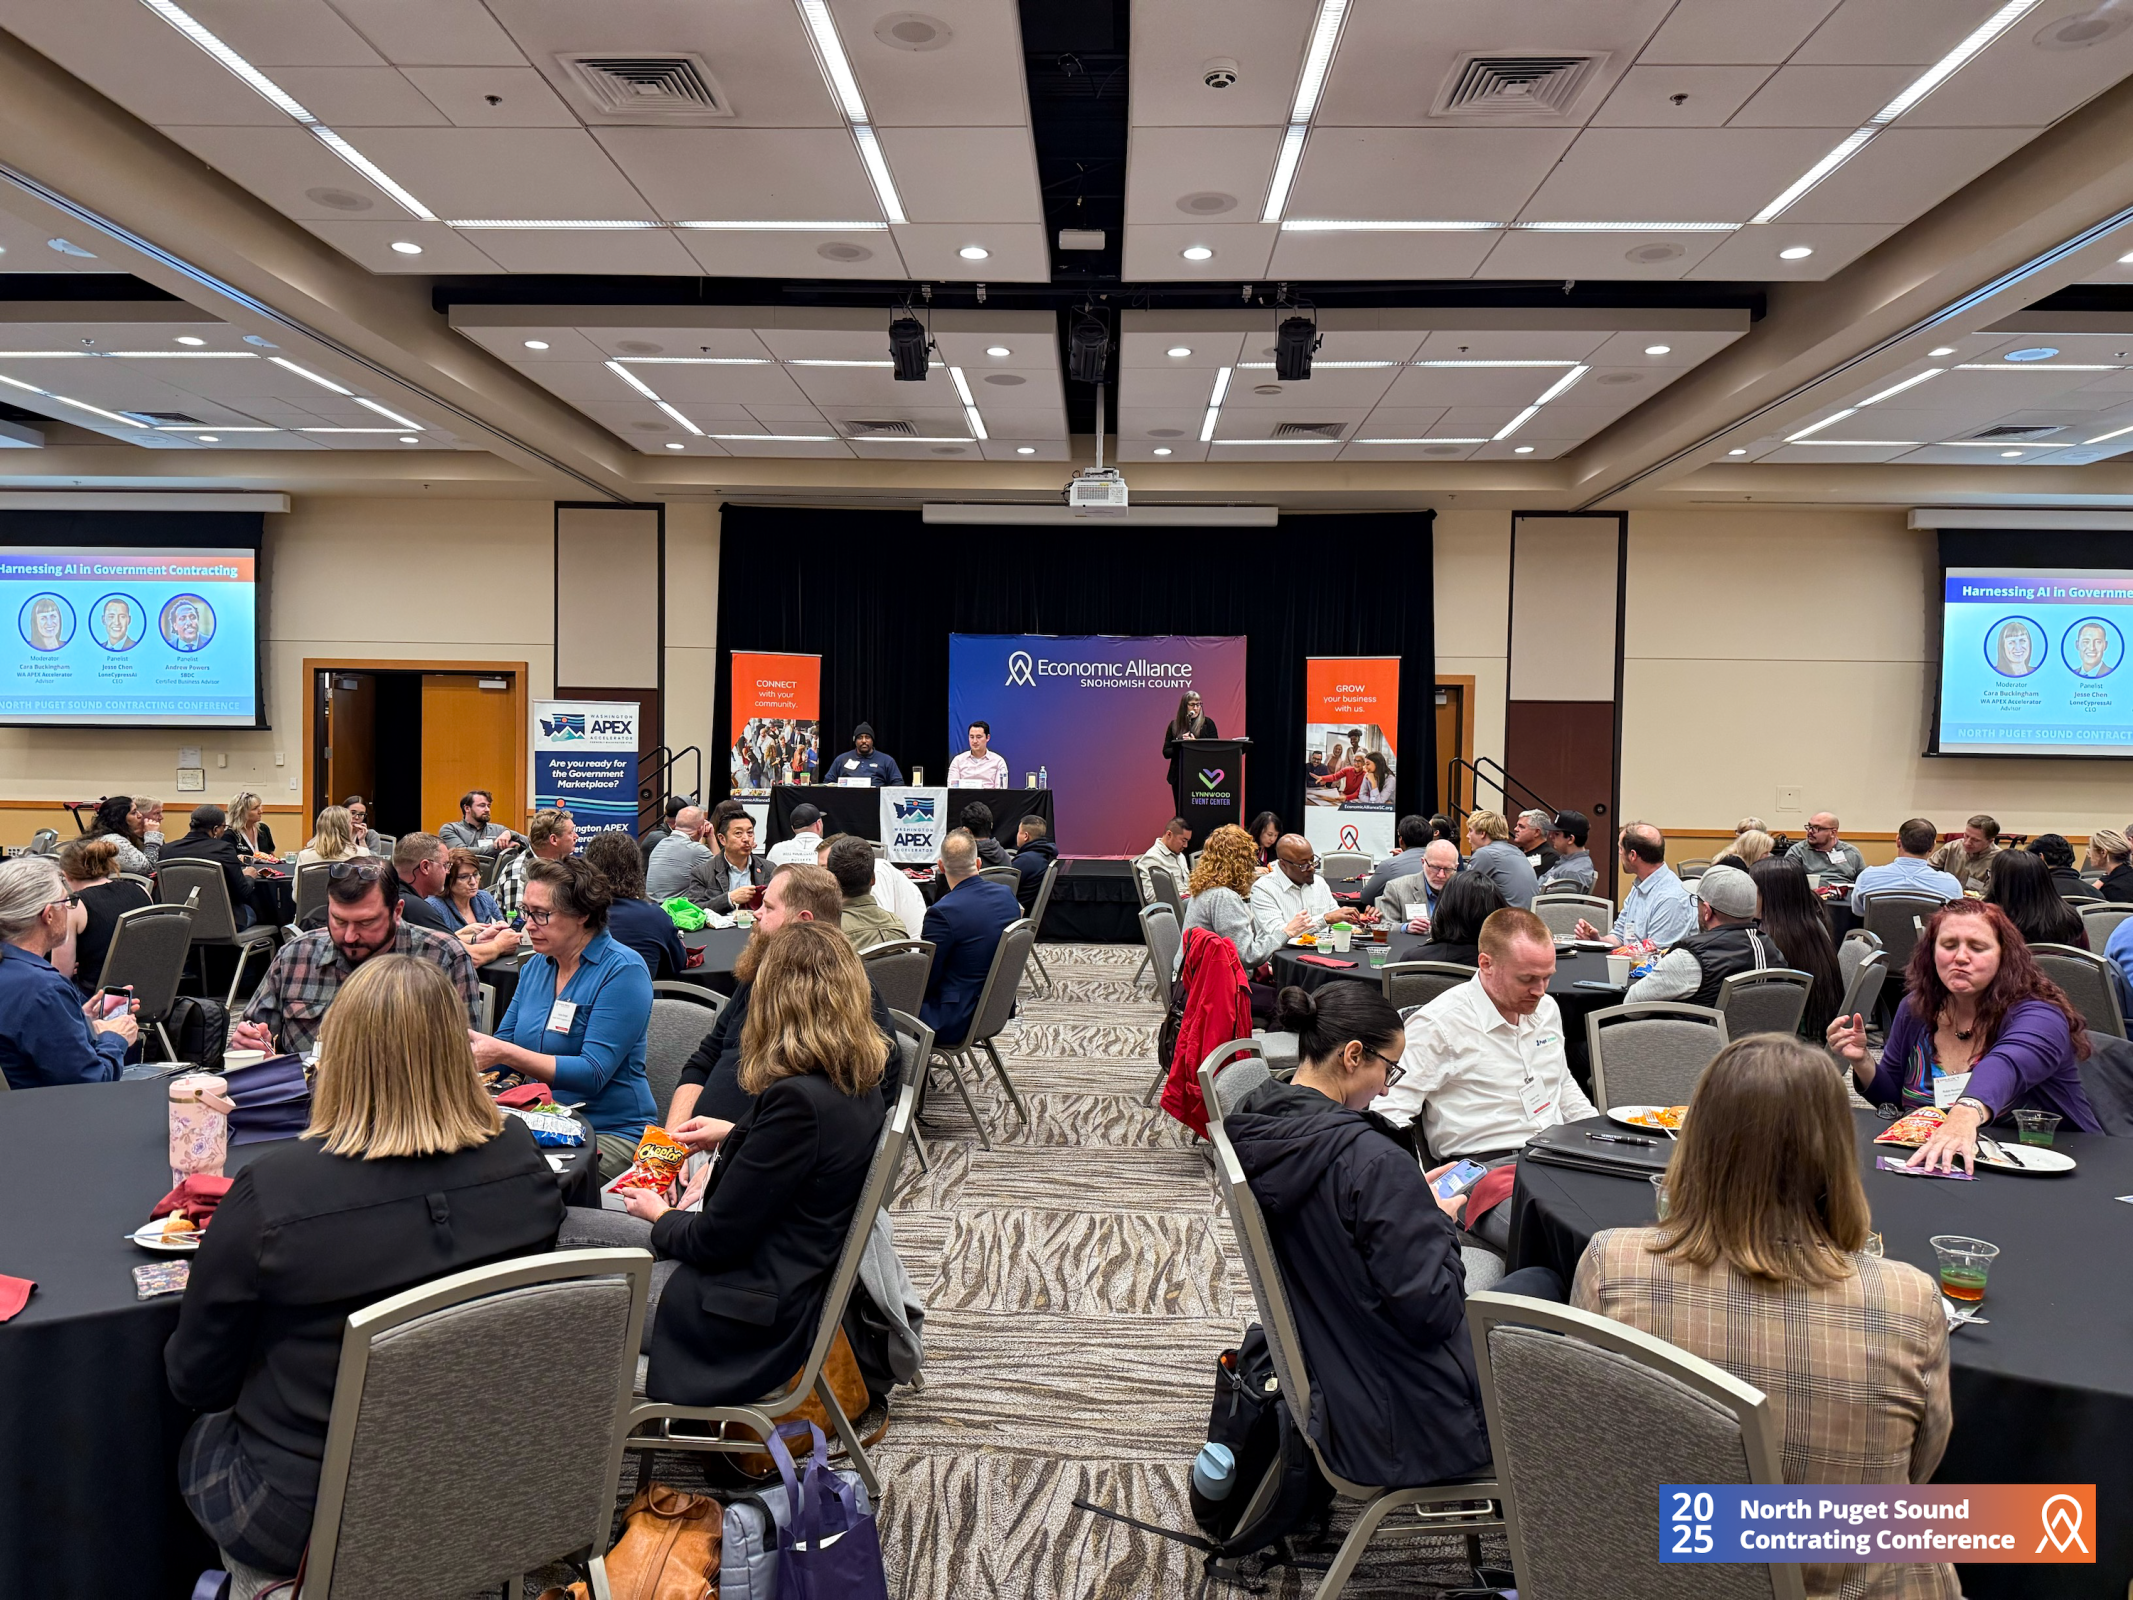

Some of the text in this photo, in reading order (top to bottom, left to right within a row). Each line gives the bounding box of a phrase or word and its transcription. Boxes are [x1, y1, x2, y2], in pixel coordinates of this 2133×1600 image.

[64, 564, 77, 574] AI
[80, 563, 91, 575] in
[93, 564, 167, 575] Government
[169, 565, 238, 578] Contracting
[1962, 586, 2034, 599] Harnessing
[2037, 587, 2050, 597] AI
[2053, 586, 2065, 597] in
[1037, 659, 1193, 677] Economic Alliance
[756, 680, 797, 689] CONNECT
[1080, 679, 1193, 688] SNOHOMISH COUNTY
[758, 690, 776, 698] with
[1335, 685, 1365, 693] GROW
[2000, 690, 2039, 698] Buckingham
[1342, 695, 1377, 703] business
[35, 701, 66, 709] PUGET
[68, 701, 102, 709] SOUND
[105, 701, 174, 709] CONTRACTING
[177, 701, 240, 710] CONFERENCE
[754, 700, 799, 709] community.
[590, 720, 632, 734] APEX
[1958, 729, 1995, 738] NORTH
[1999, 729, 2032, 738] PUGET
[2036, 730, 2073, 739] SOUND
[549, 759, 627, 769] Are you ready for
[552, 770, 624, 778] the Government
[557, 780, 619, 790] Marketplace?
[573, 823, 629, 834] ington APEX
[894, 832, 933, 847] APEX
[639, 1144, 683, 1162] Cheetos
